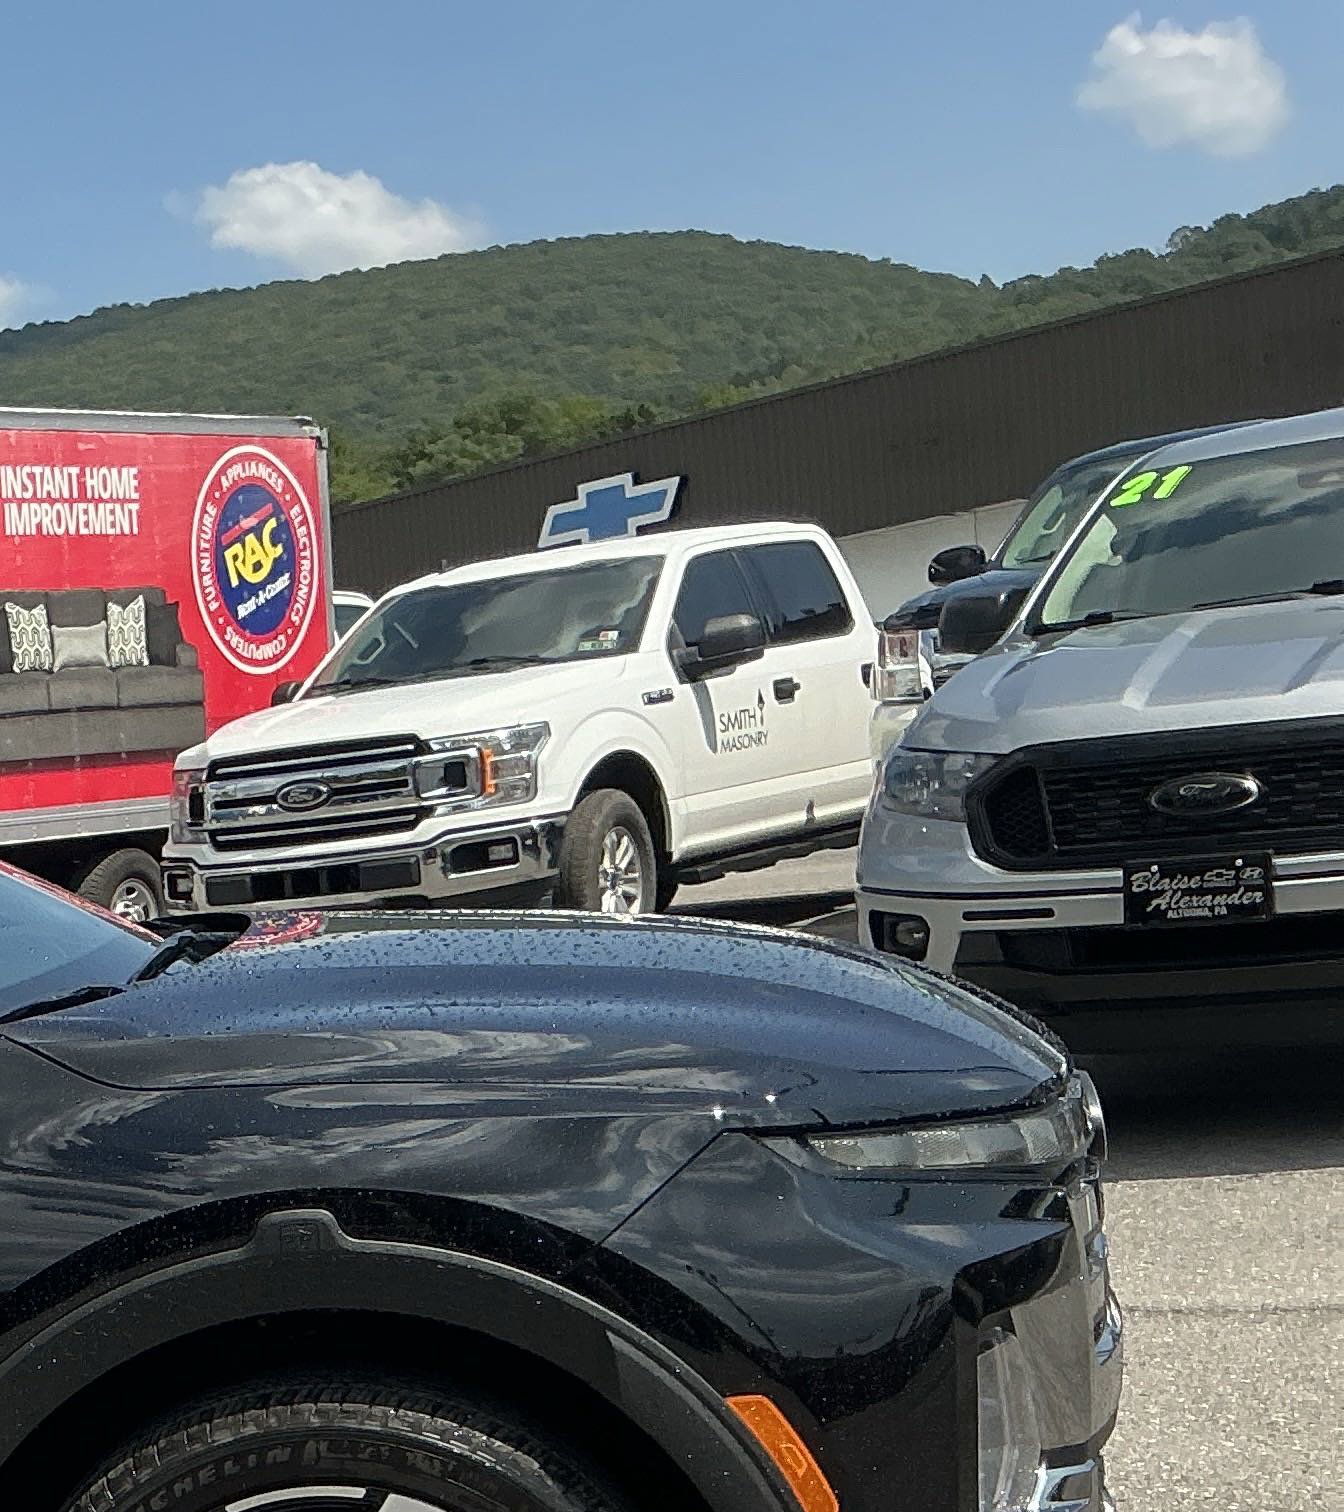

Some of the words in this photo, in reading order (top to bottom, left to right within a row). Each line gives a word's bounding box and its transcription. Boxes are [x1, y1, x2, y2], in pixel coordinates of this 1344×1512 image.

[0, 464, 80, 499] INSTANT
[85, 466, 140, 500] HOME
[219, 460, 285, 493] APPLIANCES
[1109, 465, 1192, 507] 21
[3, 502, 140, 536] IMPROVEMENT
[198, 501, 220, 613] FURNITURE
[223, 517, 283, 588] RAC
[289, 504, 312, 627] ELECTRONICS
[223, 626, 287, 660] COMPUTERS
[719, 707, 758, 733] SMITH
[720, 730, 769, 754] MASONRY
[1130, 871, 1202, 892] Blaise
[1146, 886, 1265, 912] Alexander
